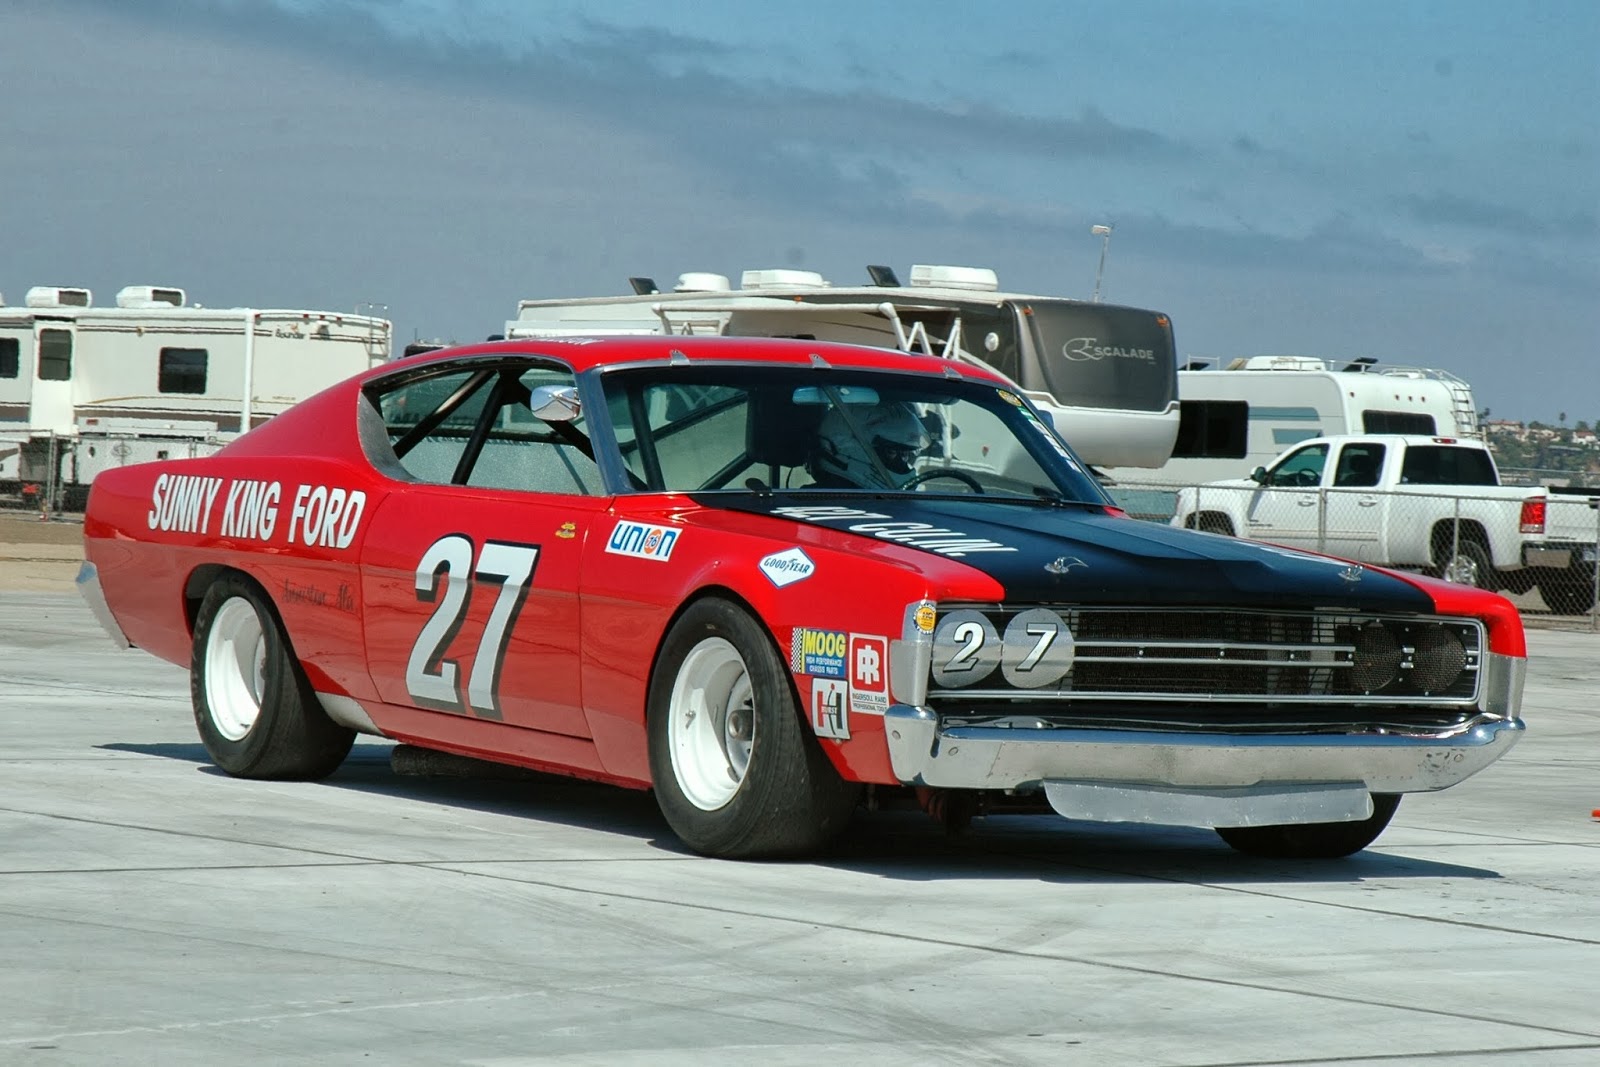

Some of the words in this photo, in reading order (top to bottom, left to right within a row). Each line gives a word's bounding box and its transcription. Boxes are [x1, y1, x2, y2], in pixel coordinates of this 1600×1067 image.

[148, 473, 223, 534] SUNNY
[220, 479, 282, 541] KING
[287, 484, 367, 549] FORD
[405, 532, 541, 720] 27
[805, 631, 846, 658] MOOG
[942, 621, 985, 673] 2
[1015, 622, 1058, 672] 7
[809, 664, 825, 674] CHASSIS
[826, 666, 838, 675] PARTS
[816, 657, 842, 667] PERFORMANCE
[852, 693, 873, 702] INGERSOLL
[875, 695, 887, 704] RAND
[853, 702, 876, 712] PROFESSIONAL
